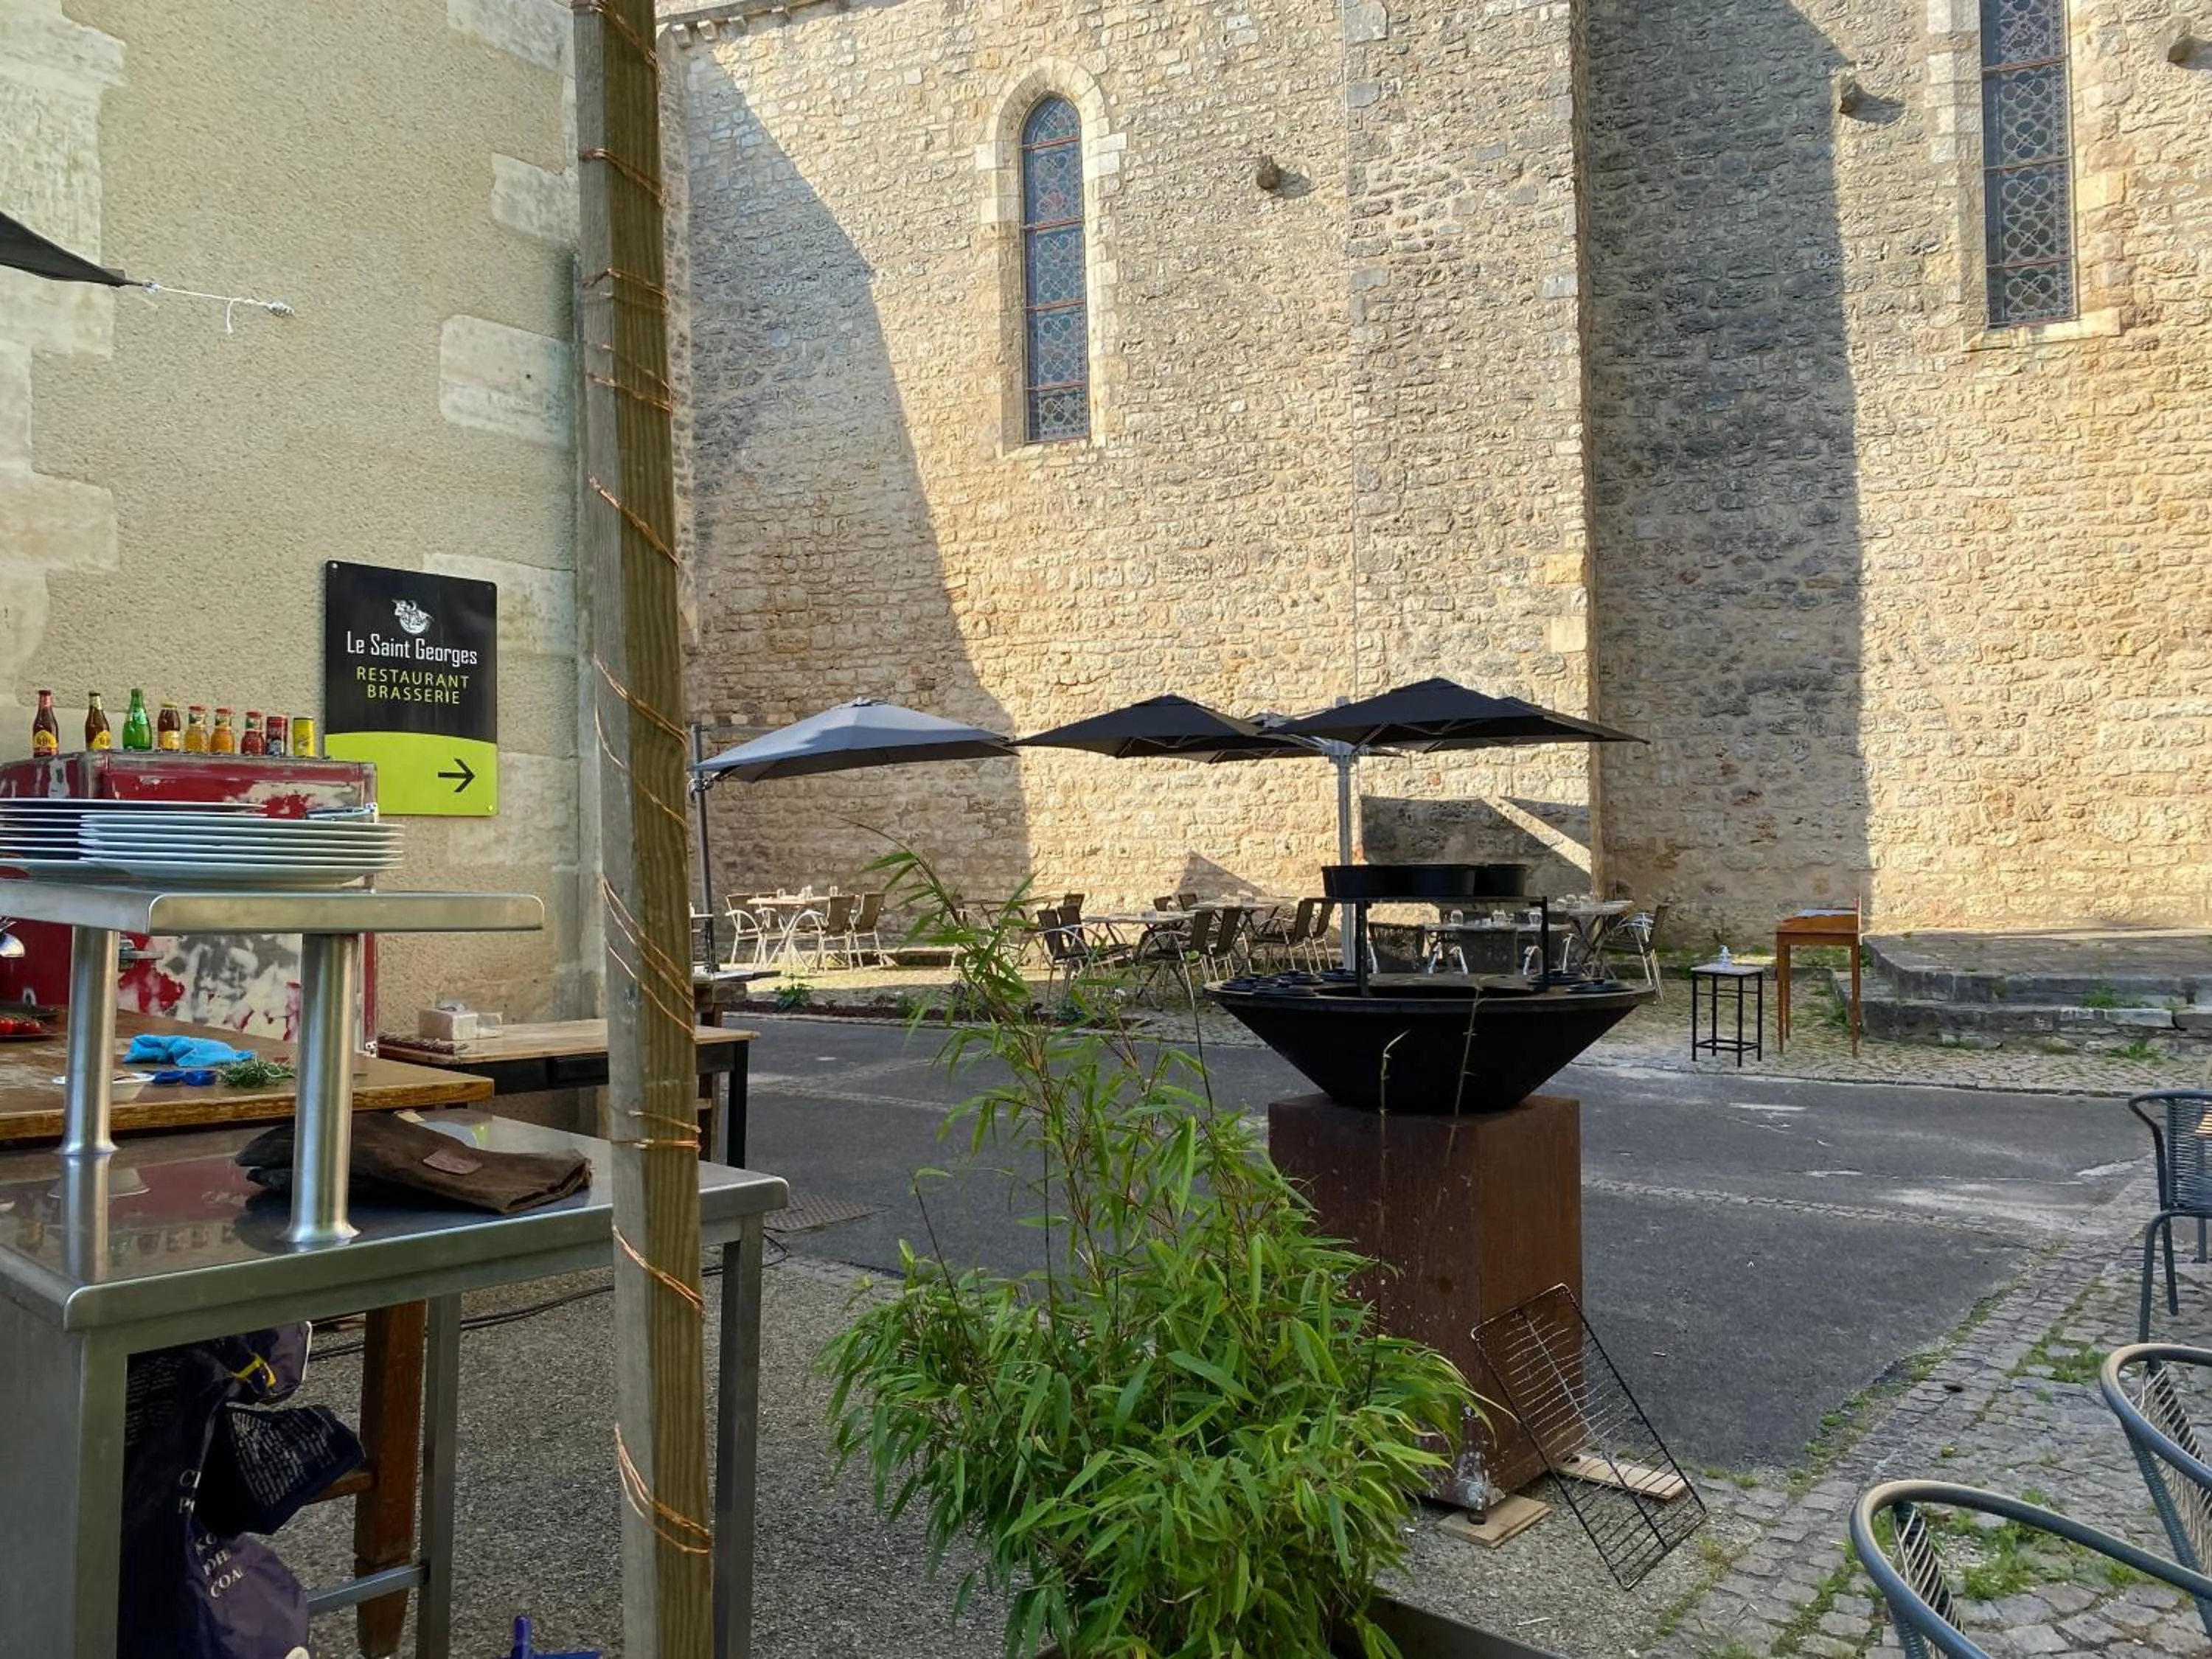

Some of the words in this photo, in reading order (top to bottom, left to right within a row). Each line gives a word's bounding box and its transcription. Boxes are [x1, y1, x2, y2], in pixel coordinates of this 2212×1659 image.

[347, 630, 365, 654] Le
[371, 633, 411, 658] Saint
[415, 638, 478, 667] Georges
[356, 667, 470, 689] RESTAURANT
[368, 684, 460, 704] BRASSERIE
